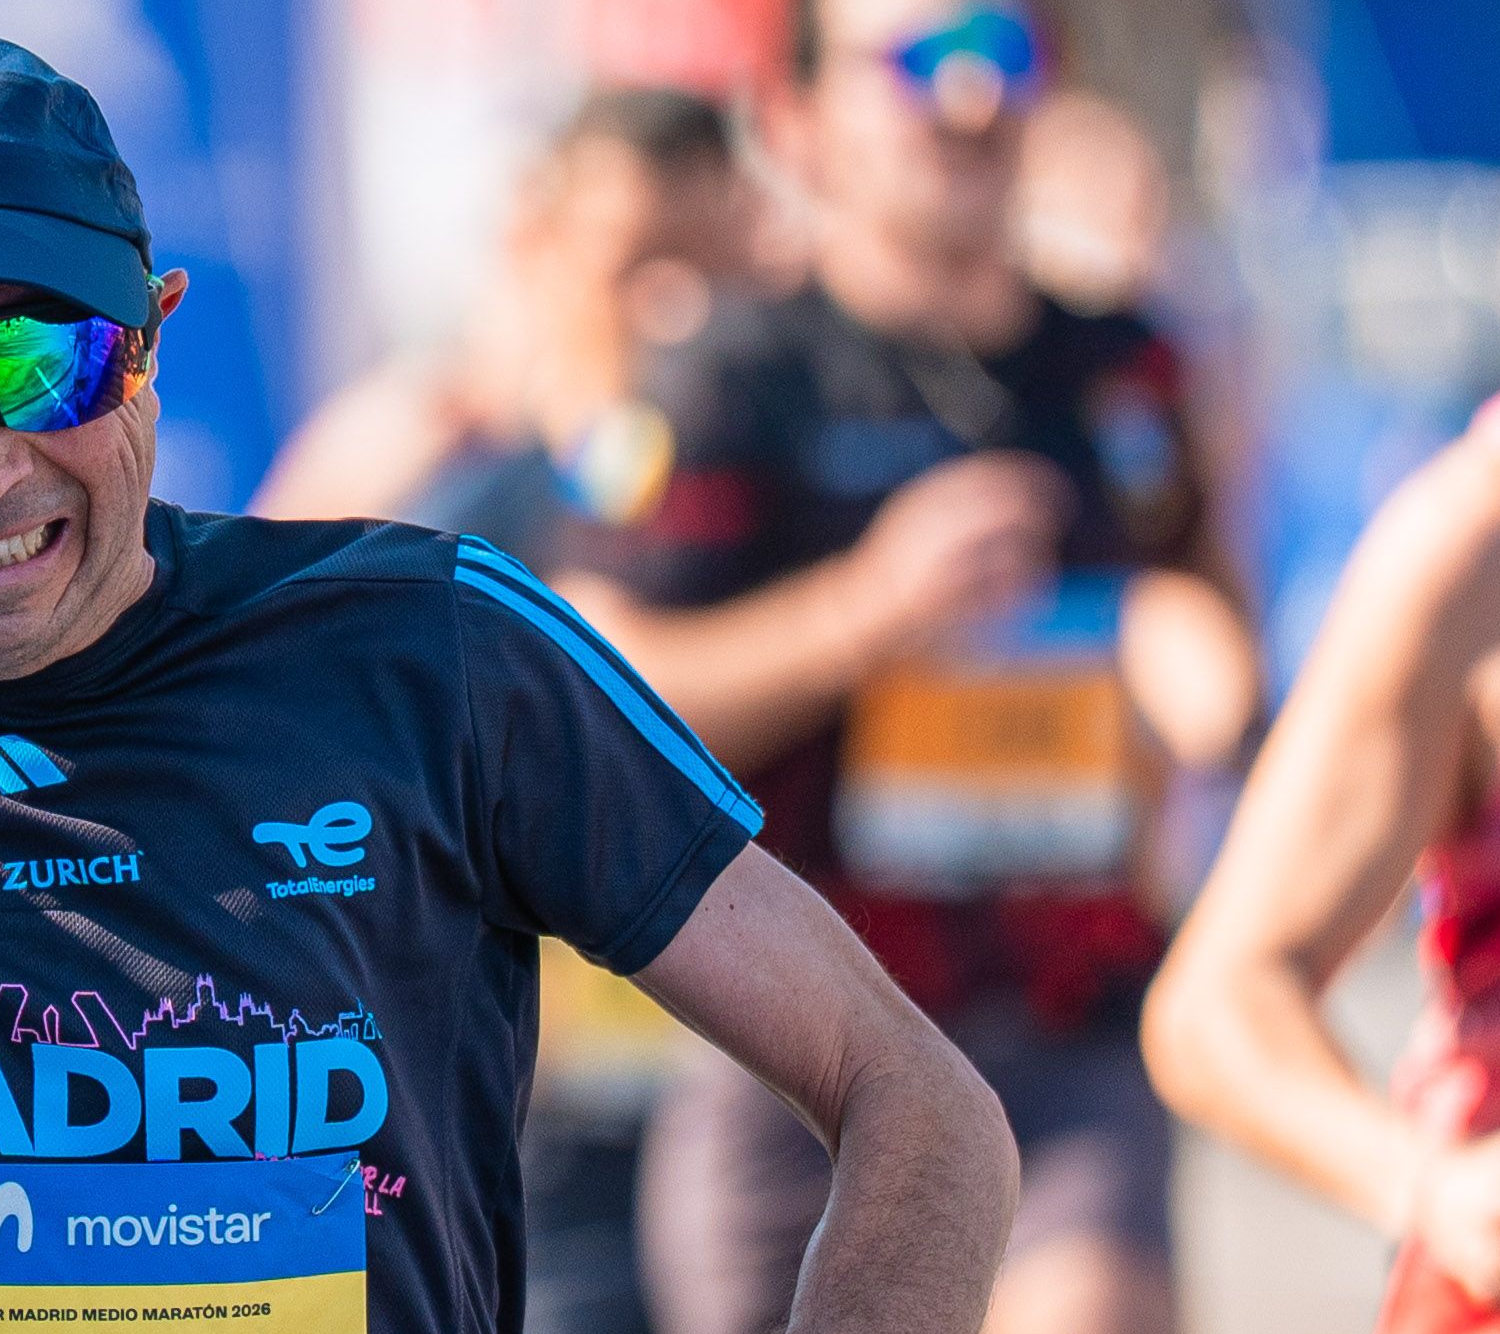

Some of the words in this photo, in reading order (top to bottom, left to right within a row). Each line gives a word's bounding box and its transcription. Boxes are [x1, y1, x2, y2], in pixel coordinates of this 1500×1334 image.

[2, 851, 143, 891] ZURICH
[265, 874, 376, 899] TotalEnergies
[67, 1204, 271, 1247] movistar
[8, 1308, 78, 1322] MADRID
[82, 1308, 138, 1322] MEDIO
[142, 1304, 228, 1321] MARATÓN
[231, 1302, 272, 1318] 2026
